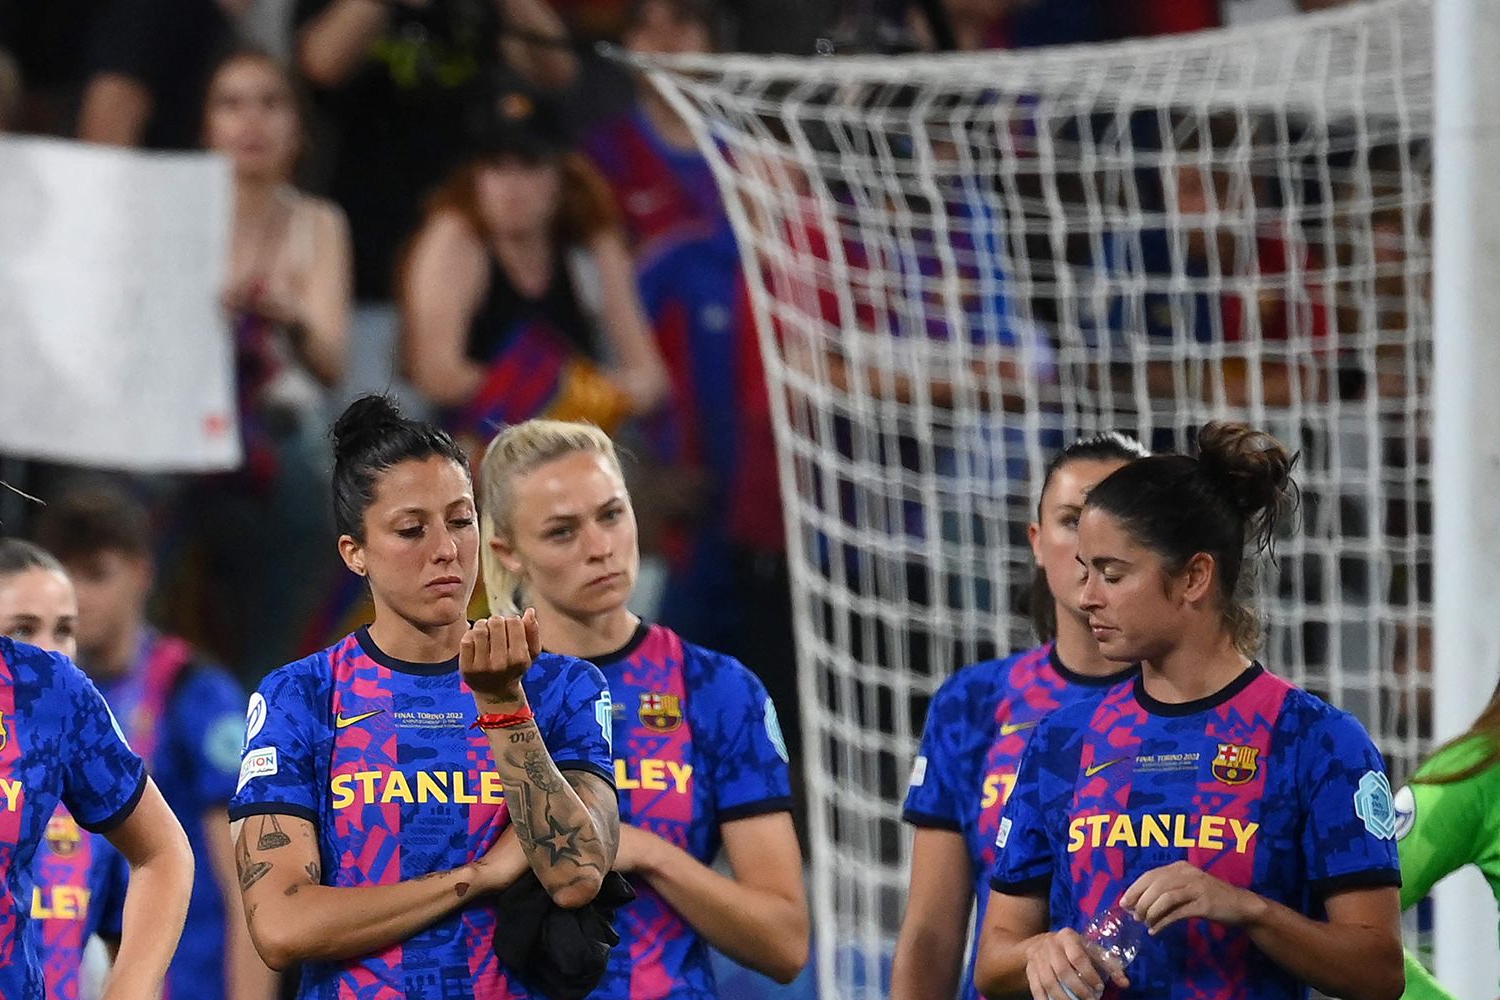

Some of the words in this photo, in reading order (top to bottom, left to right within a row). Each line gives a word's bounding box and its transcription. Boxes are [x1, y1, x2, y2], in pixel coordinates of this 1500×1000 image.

[331, 771, 504, 809] STANLE
[615, 760, 693, 793] LEY
[1068, 815, 1259, 853] STANLEY
[31, 886, 91, 919] LEY
